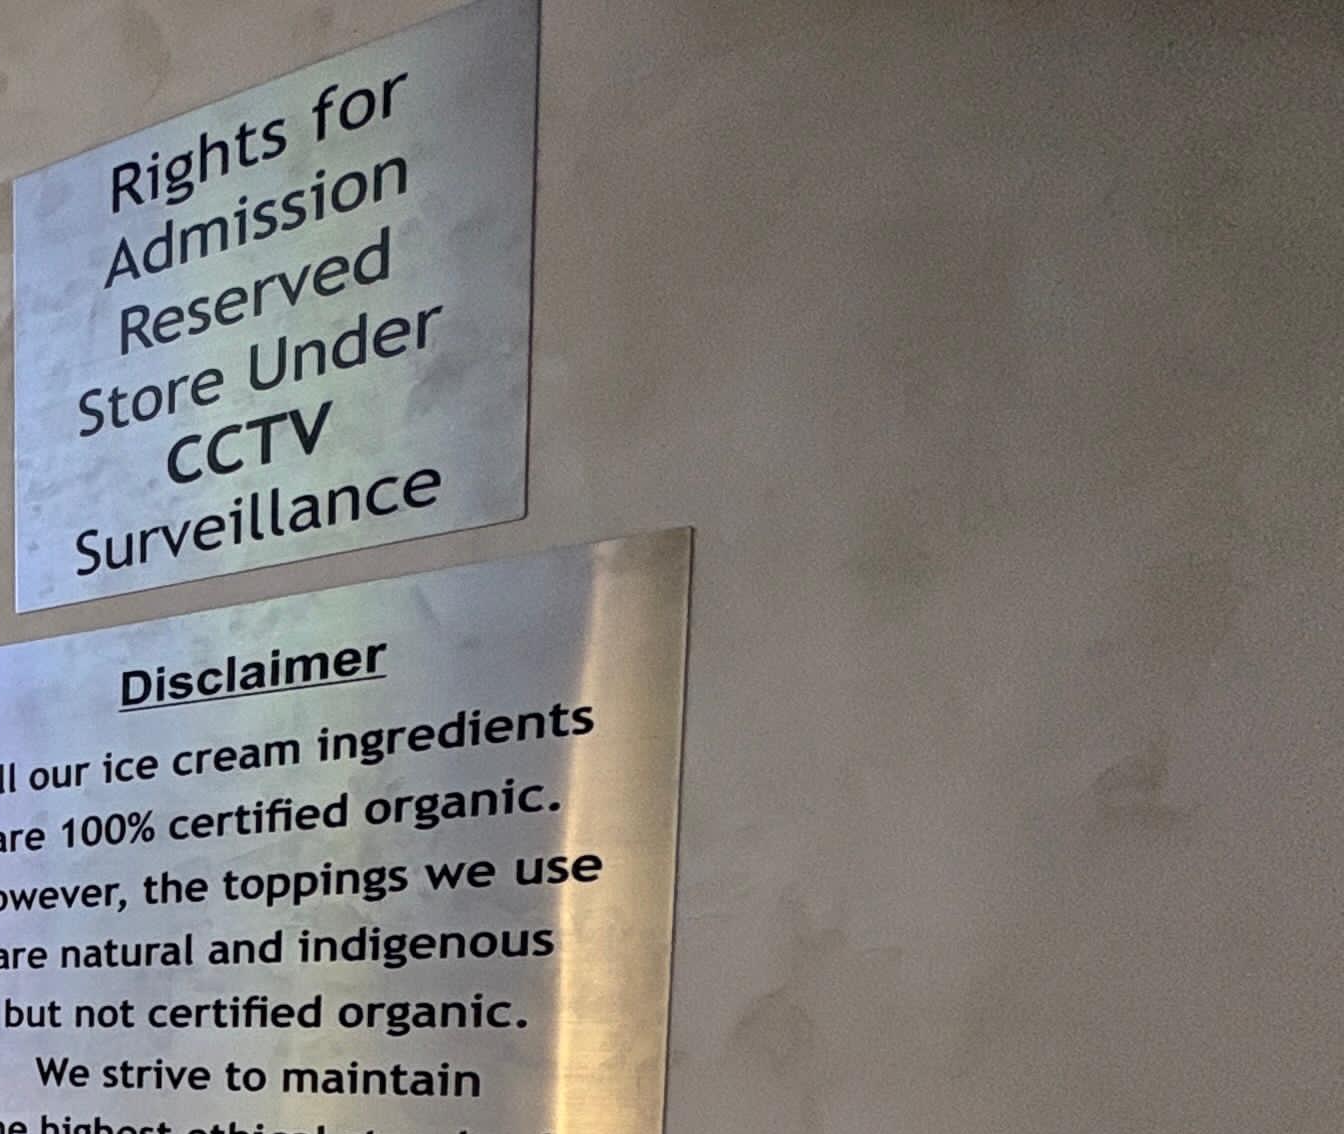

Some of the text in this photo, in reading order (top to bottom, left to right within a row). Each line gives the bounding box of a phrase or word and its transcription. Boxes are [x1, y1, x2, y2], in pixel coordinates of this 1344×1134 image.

[112, 71, 408, 213] Rights for
[104, 155, 408, 289] Admission
[120, 225, 391, 356] Reserved
[78, 304, 443, 438] Store Under
[167, 400, 333, 484] CCTV
[75, 465, 443, 577] Surveillance
[119, 640, 388, 711] Disclaimer
[29, 761, 90, 792] our
[102, 753, 159, 785] ice
[172, 741, 301, 779] cream
[317, 702, 595, 766] ingredients
[60, 811, 155, 850] 100%
[168, 793, 349, 842] certified
[364, 778, 562, 833] organic.
[143, 871, 209, 905] the
[222, 859, 409, 908] toppings
[424, 855, 497, 891] we
[514, 849, 604, 886] use
[60, 935, 194, 970] natural
[208, 930, 283, 966] and
[297, 926, 556, 970] indigenous
[4, 993, 529, 1037] but not certified organic.
[35, 1056, 482, 1098] We strive to maintain
